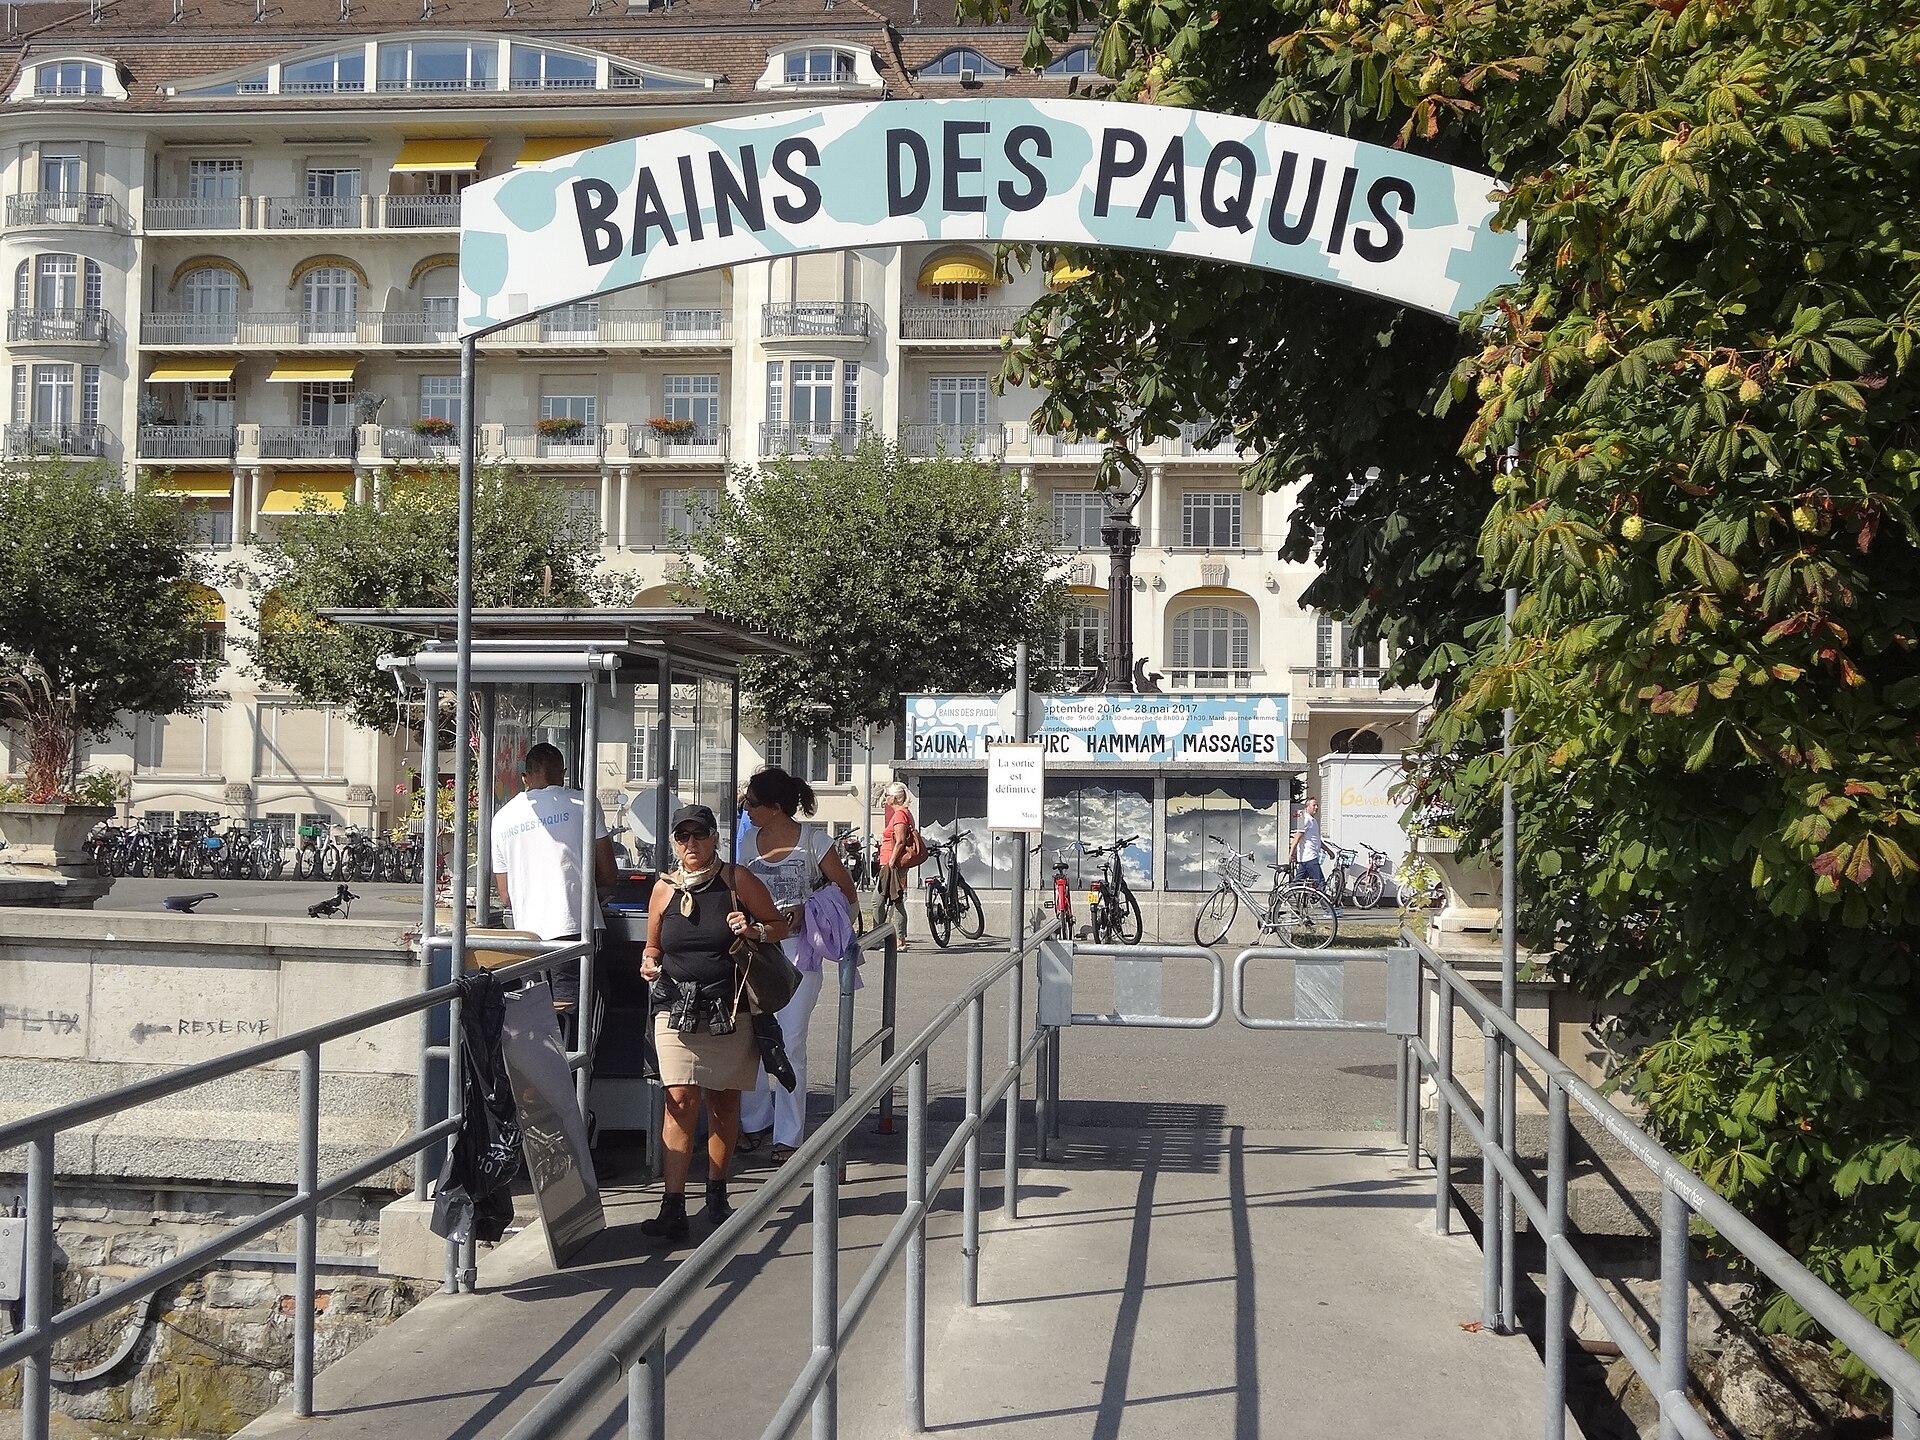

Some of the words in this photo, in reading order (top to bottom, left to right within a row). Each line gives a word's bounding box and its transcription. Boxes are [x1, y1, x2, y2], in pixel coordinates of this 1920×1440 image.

[572, 137, 822, 266] BAINS
[886, 121, 1052, 217] DES
[1093, 128, 1416, 263] PAQUIS
[938, 708, 960, 717] BAINS
[960, 708, 975, 717] DES
[975, 708, 997, 717] PAQUI
[1044, 704, 1094, 715] eptembre
[1097, 704, 1121, 714] 2016
[1134, 704, 1147, 714] 28
[1149, 704, 1169, 714] mai
[1172, 704, 1198, 714] 2017
[914, 734, 968, 753] SAUNA
[1086, 734, 1165, 753] HAMMAM
[1183, 734, 1275, 753] MASSAGES
[998, 758, 1009, 768] La
[1011, 758, 1035, 768] sortie
[1009, 773, 1022, 781] est
[995, 784, 1037, 794] définitive
[520, 820, 536, 833] DES
[537, 812, 570, 828] PAQUIS
[178, 1018, 269, 1037] RESERVE
